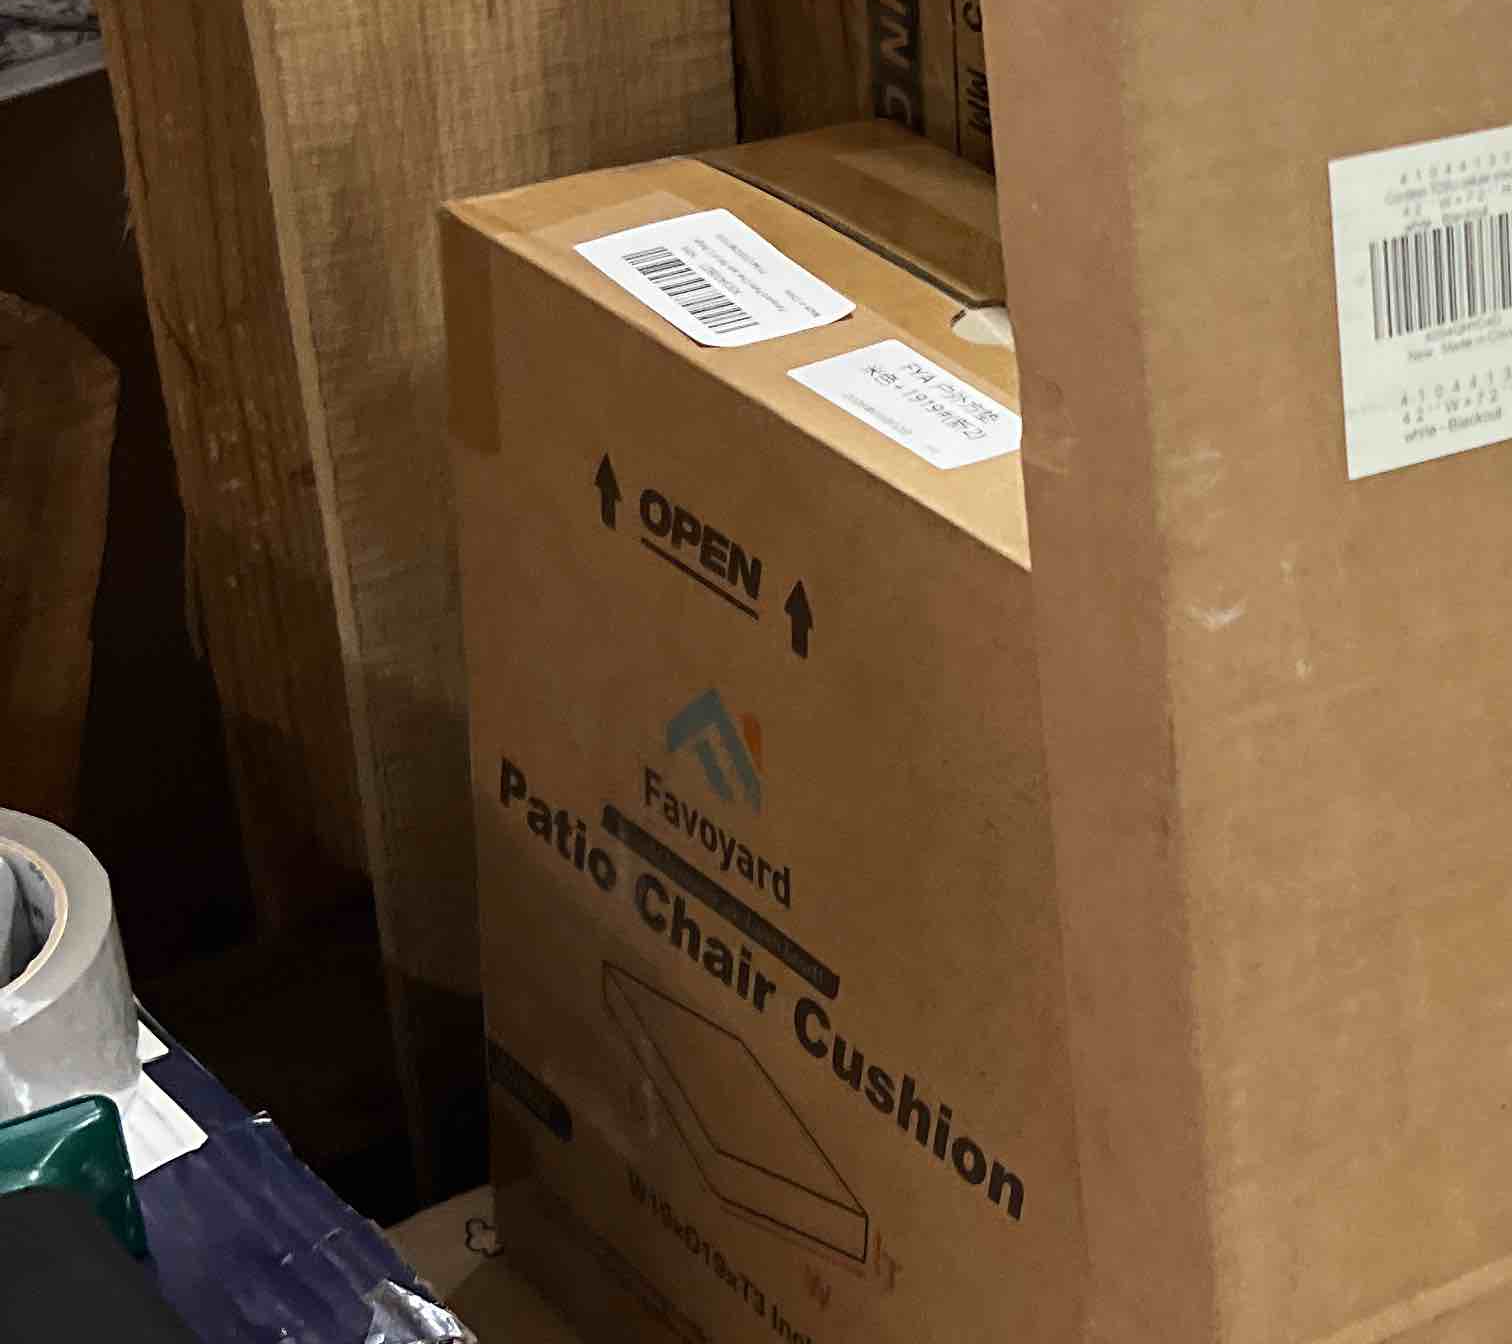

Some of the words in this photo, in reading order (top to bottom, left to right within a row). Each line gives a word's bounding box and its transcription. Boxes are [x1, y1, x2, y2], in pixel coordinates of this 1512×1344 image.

[639, 487, 762, 599] OPEN
[642, 766, 792, 910] Favoyard
[500, 757, 617, 892] Patio
[634, 874, 777, 1012] Chair
[793, 997, 1025, 1222] Cushion
